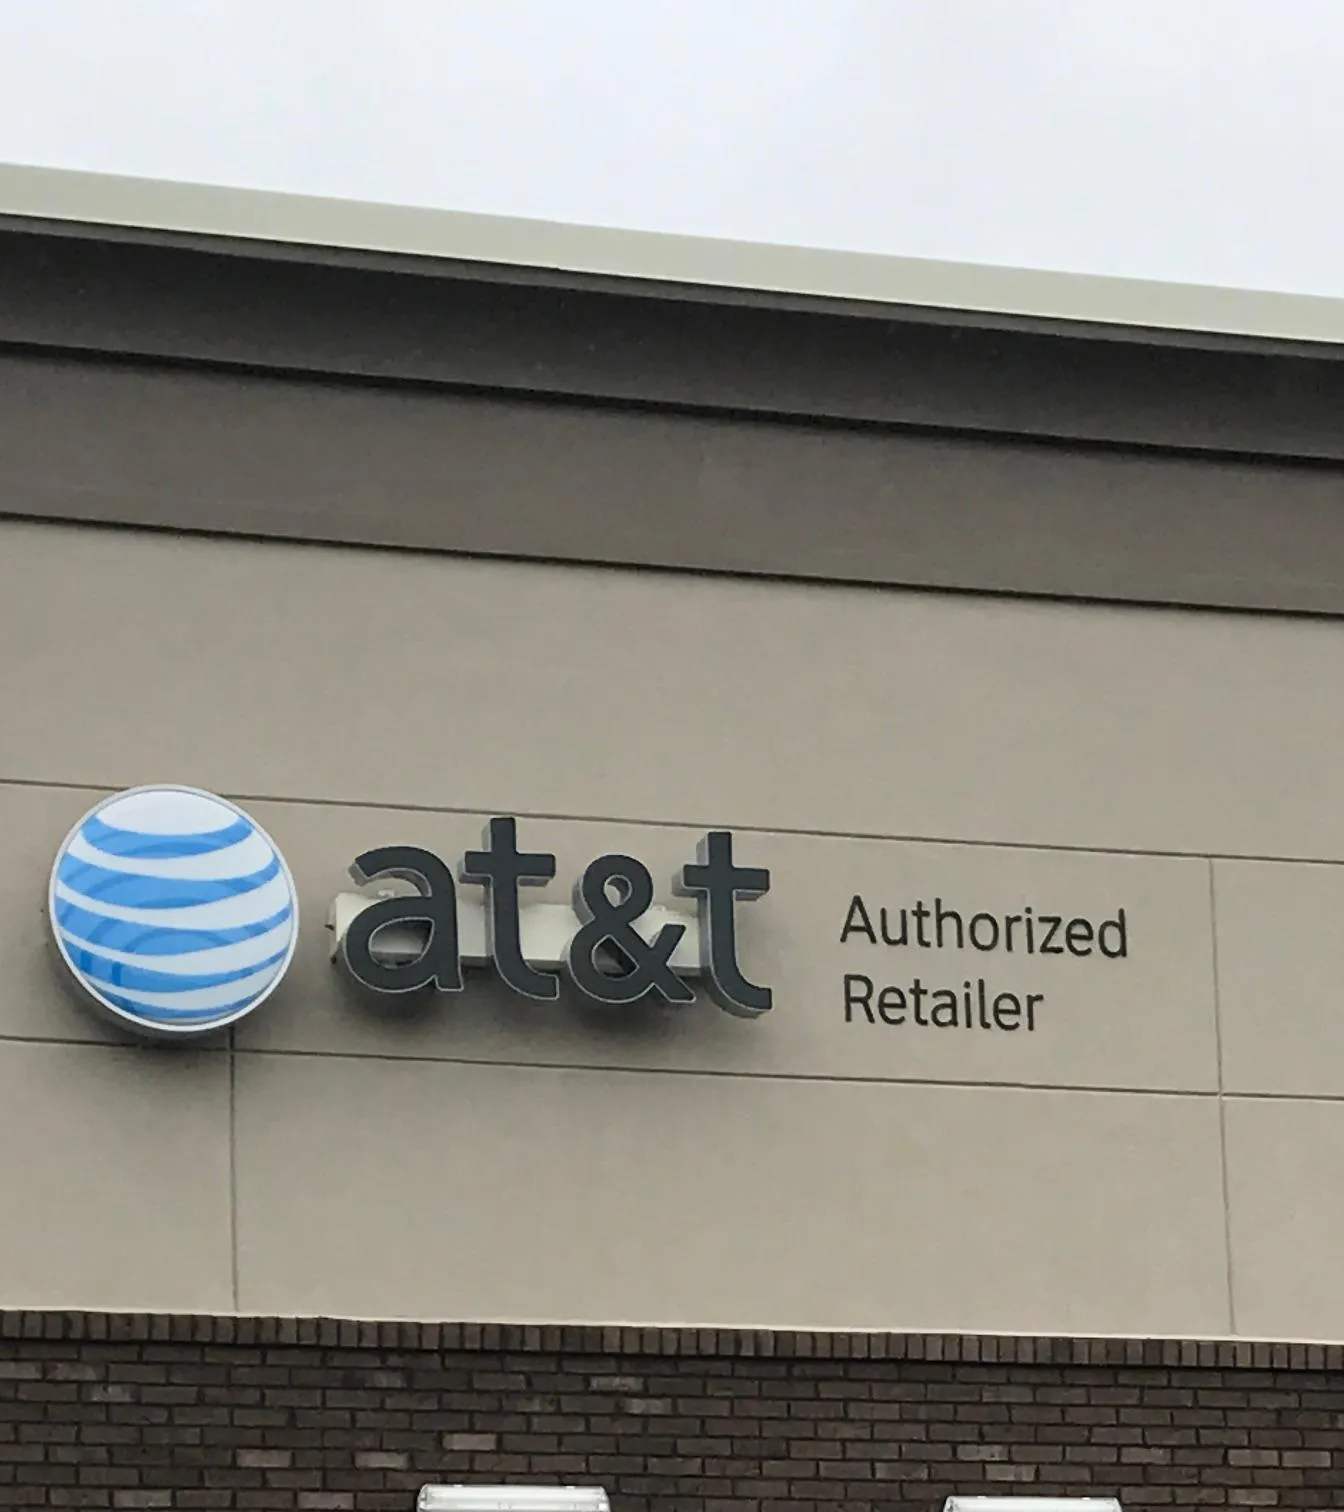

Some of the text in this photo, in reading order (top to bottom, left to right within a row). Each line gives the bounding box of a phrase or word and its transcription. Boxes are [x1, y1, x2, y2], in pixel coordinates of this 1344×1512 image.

[344, 816, 773, 1017] at&t
[840, 894, 1128, 958] Authorized
[843, 973, 1044, 1032] Retailer
